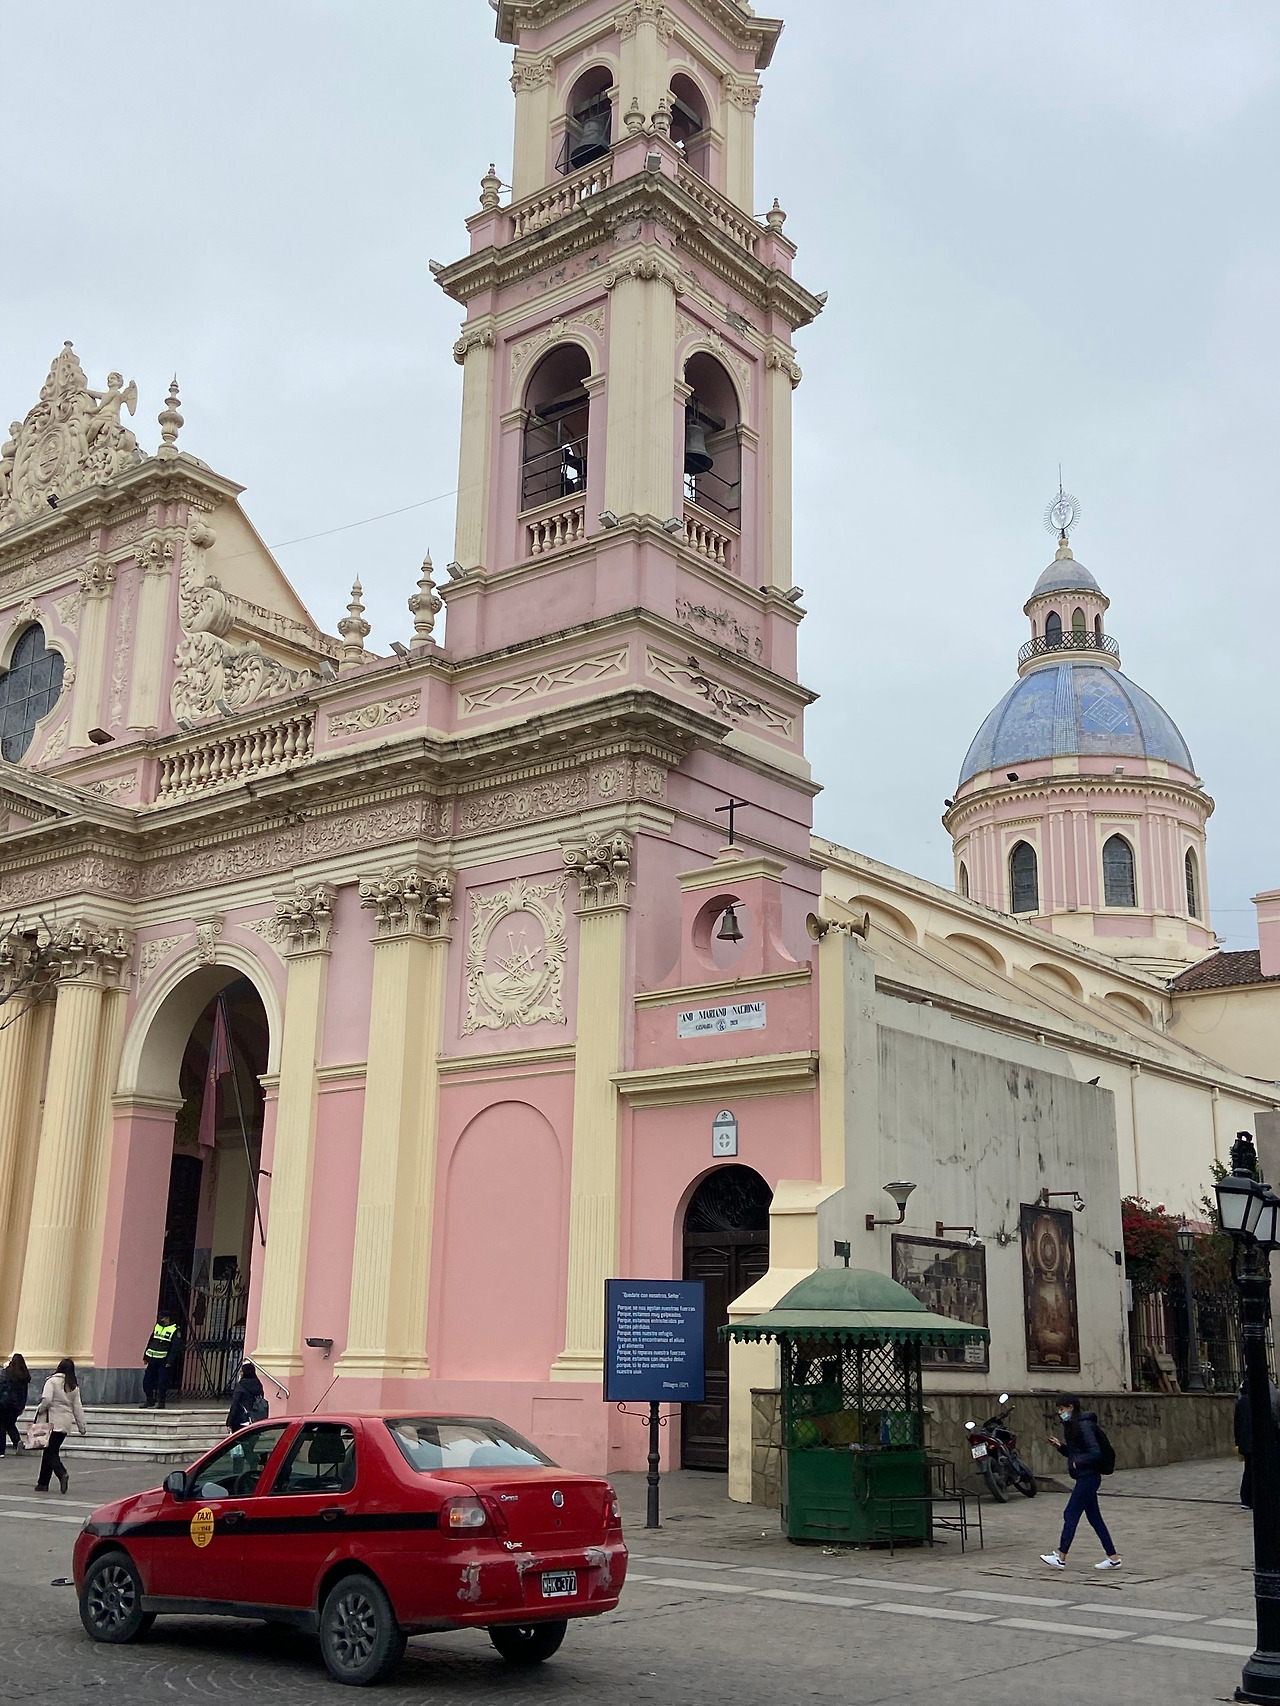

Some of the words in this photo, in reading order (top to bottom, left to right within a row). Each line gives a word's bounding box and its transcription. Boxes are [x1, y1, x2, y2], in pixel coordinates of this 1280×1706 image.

[699, 1008, 726, 1019] MARIANO
[733, 1003, 762, 1014] NACIONAL
[197, 1512, 211, 1520] TAXI
[561, 1577, 575, 1590] 377
